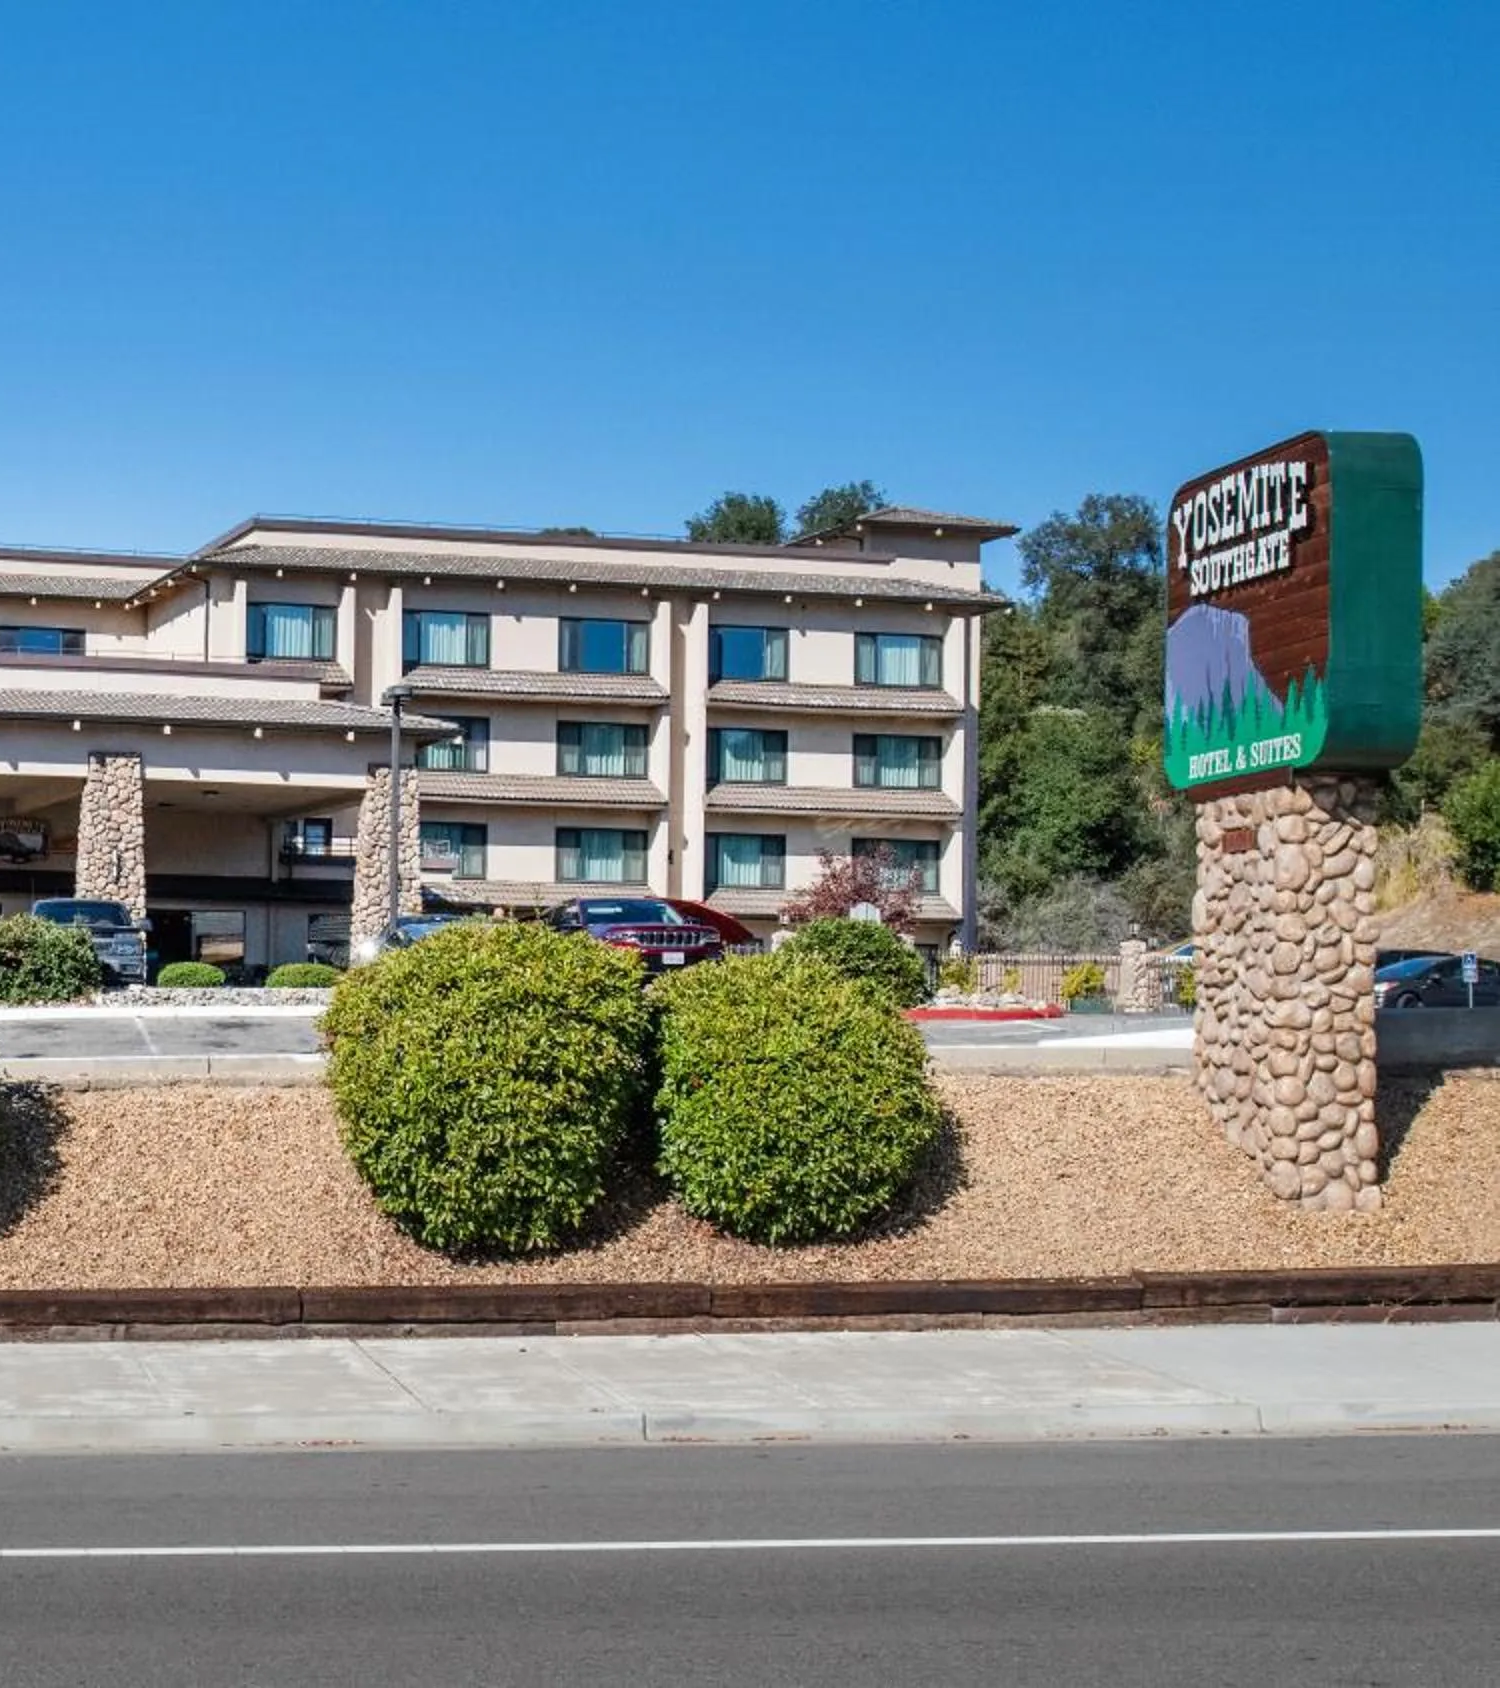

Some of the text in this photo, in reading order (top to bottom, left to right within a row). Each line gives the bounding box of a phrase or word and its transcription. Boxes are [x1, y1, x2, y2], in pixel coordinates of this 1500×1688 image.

[1173, 461, 1308, 569] YOSEMITE
[1190, 529, 1290, 596] SOUTHGATE
[1189, 733, 1302, 779] HOTEL & SUITES
